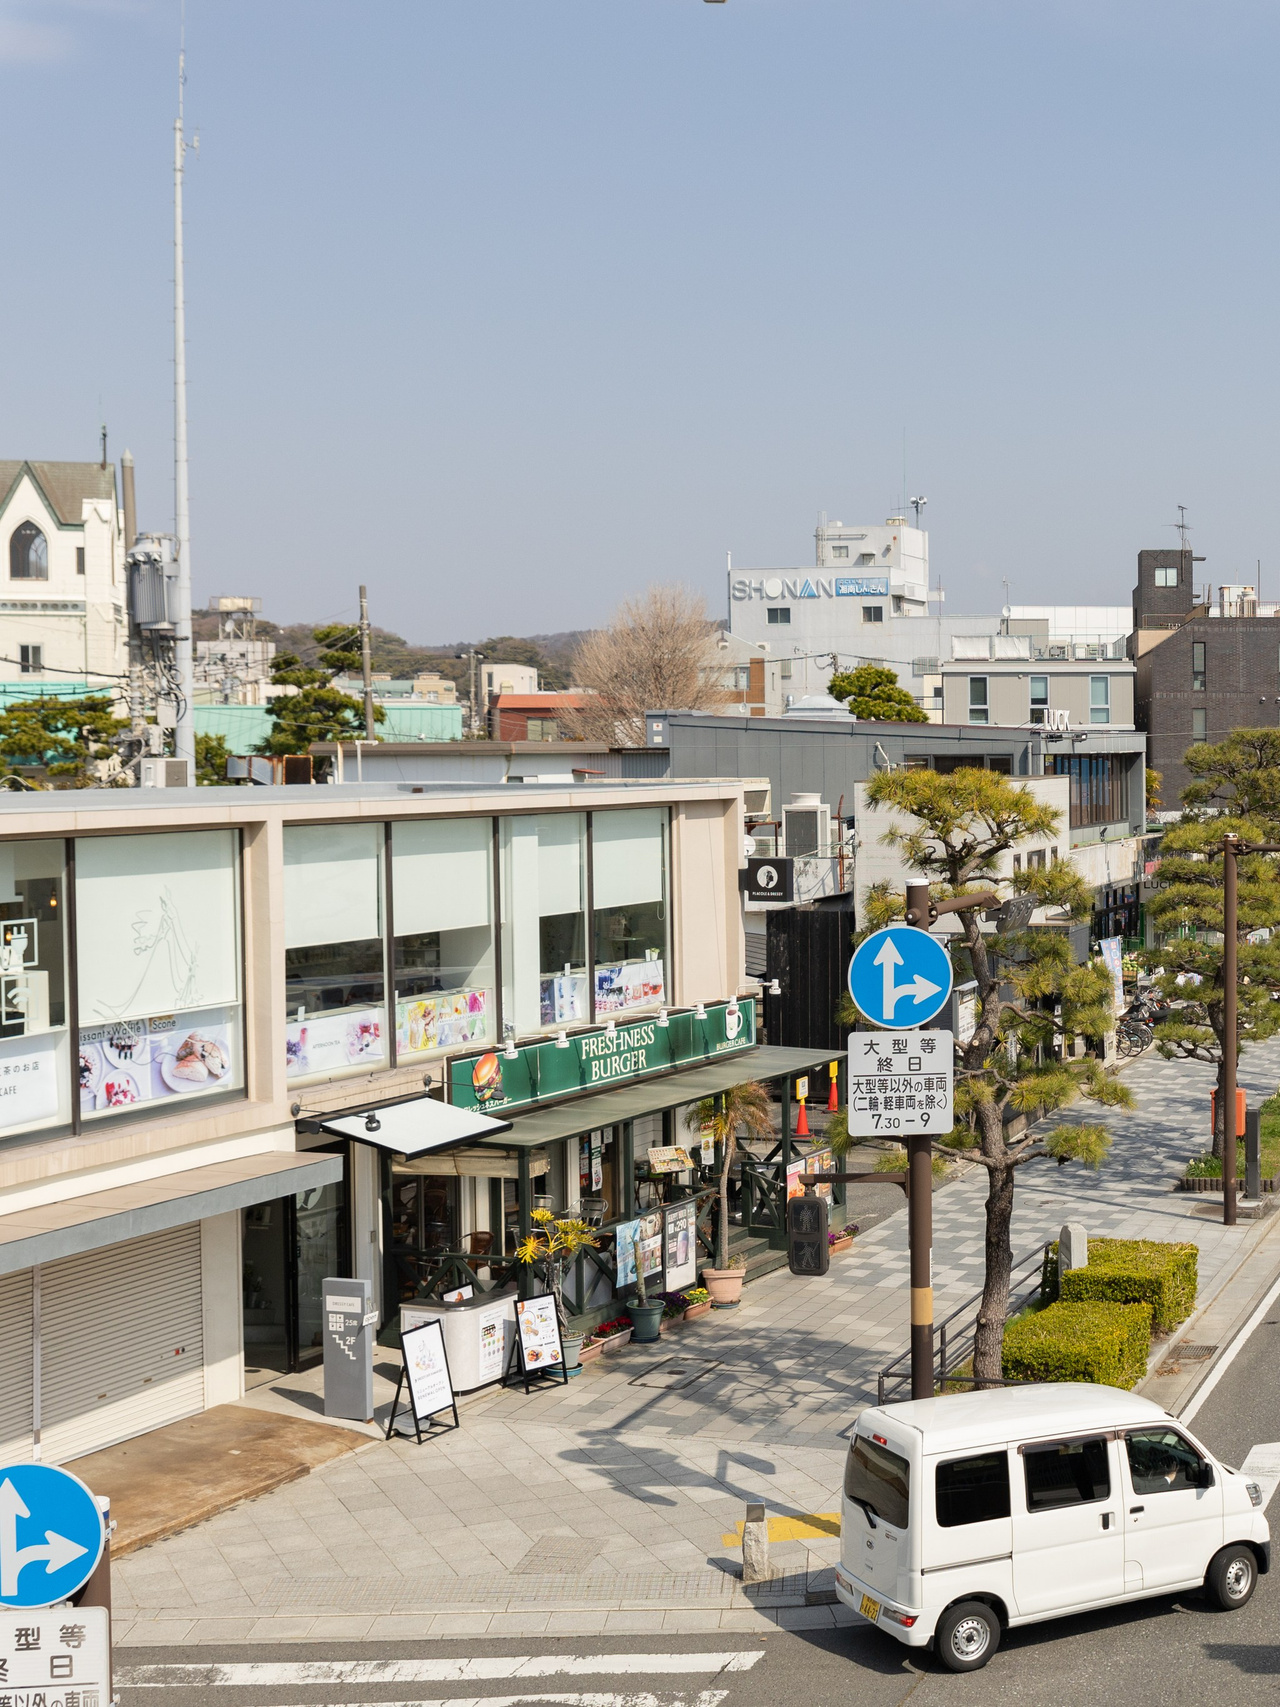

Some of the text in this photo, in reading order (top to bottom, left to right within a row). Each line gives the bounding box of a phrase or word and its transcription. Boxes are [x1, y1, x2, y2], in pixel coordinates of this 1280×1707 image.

[1044, 709, 1070, 731] LUCK
[1144, 881, 1171, 889] LUC
[152, 1017, 176, 1031] Scone
[581, 1025, 655, 1060] FRESHNESS
[716, 1036, 747, 1051] BURGER CAFE
[863, 1037, 937, 1056] 大型等
[0, 1060, 40, 1077] 茶のお店
[591, 1048, 647, 1081] BURGER
[877, 1056, 922, 1073] 終日
[852, 1076, 948, 1095] 大型等以外の車両
[346, 1336, 356, 1345] 2F
[14, 1624, 87, 1652] 型等
